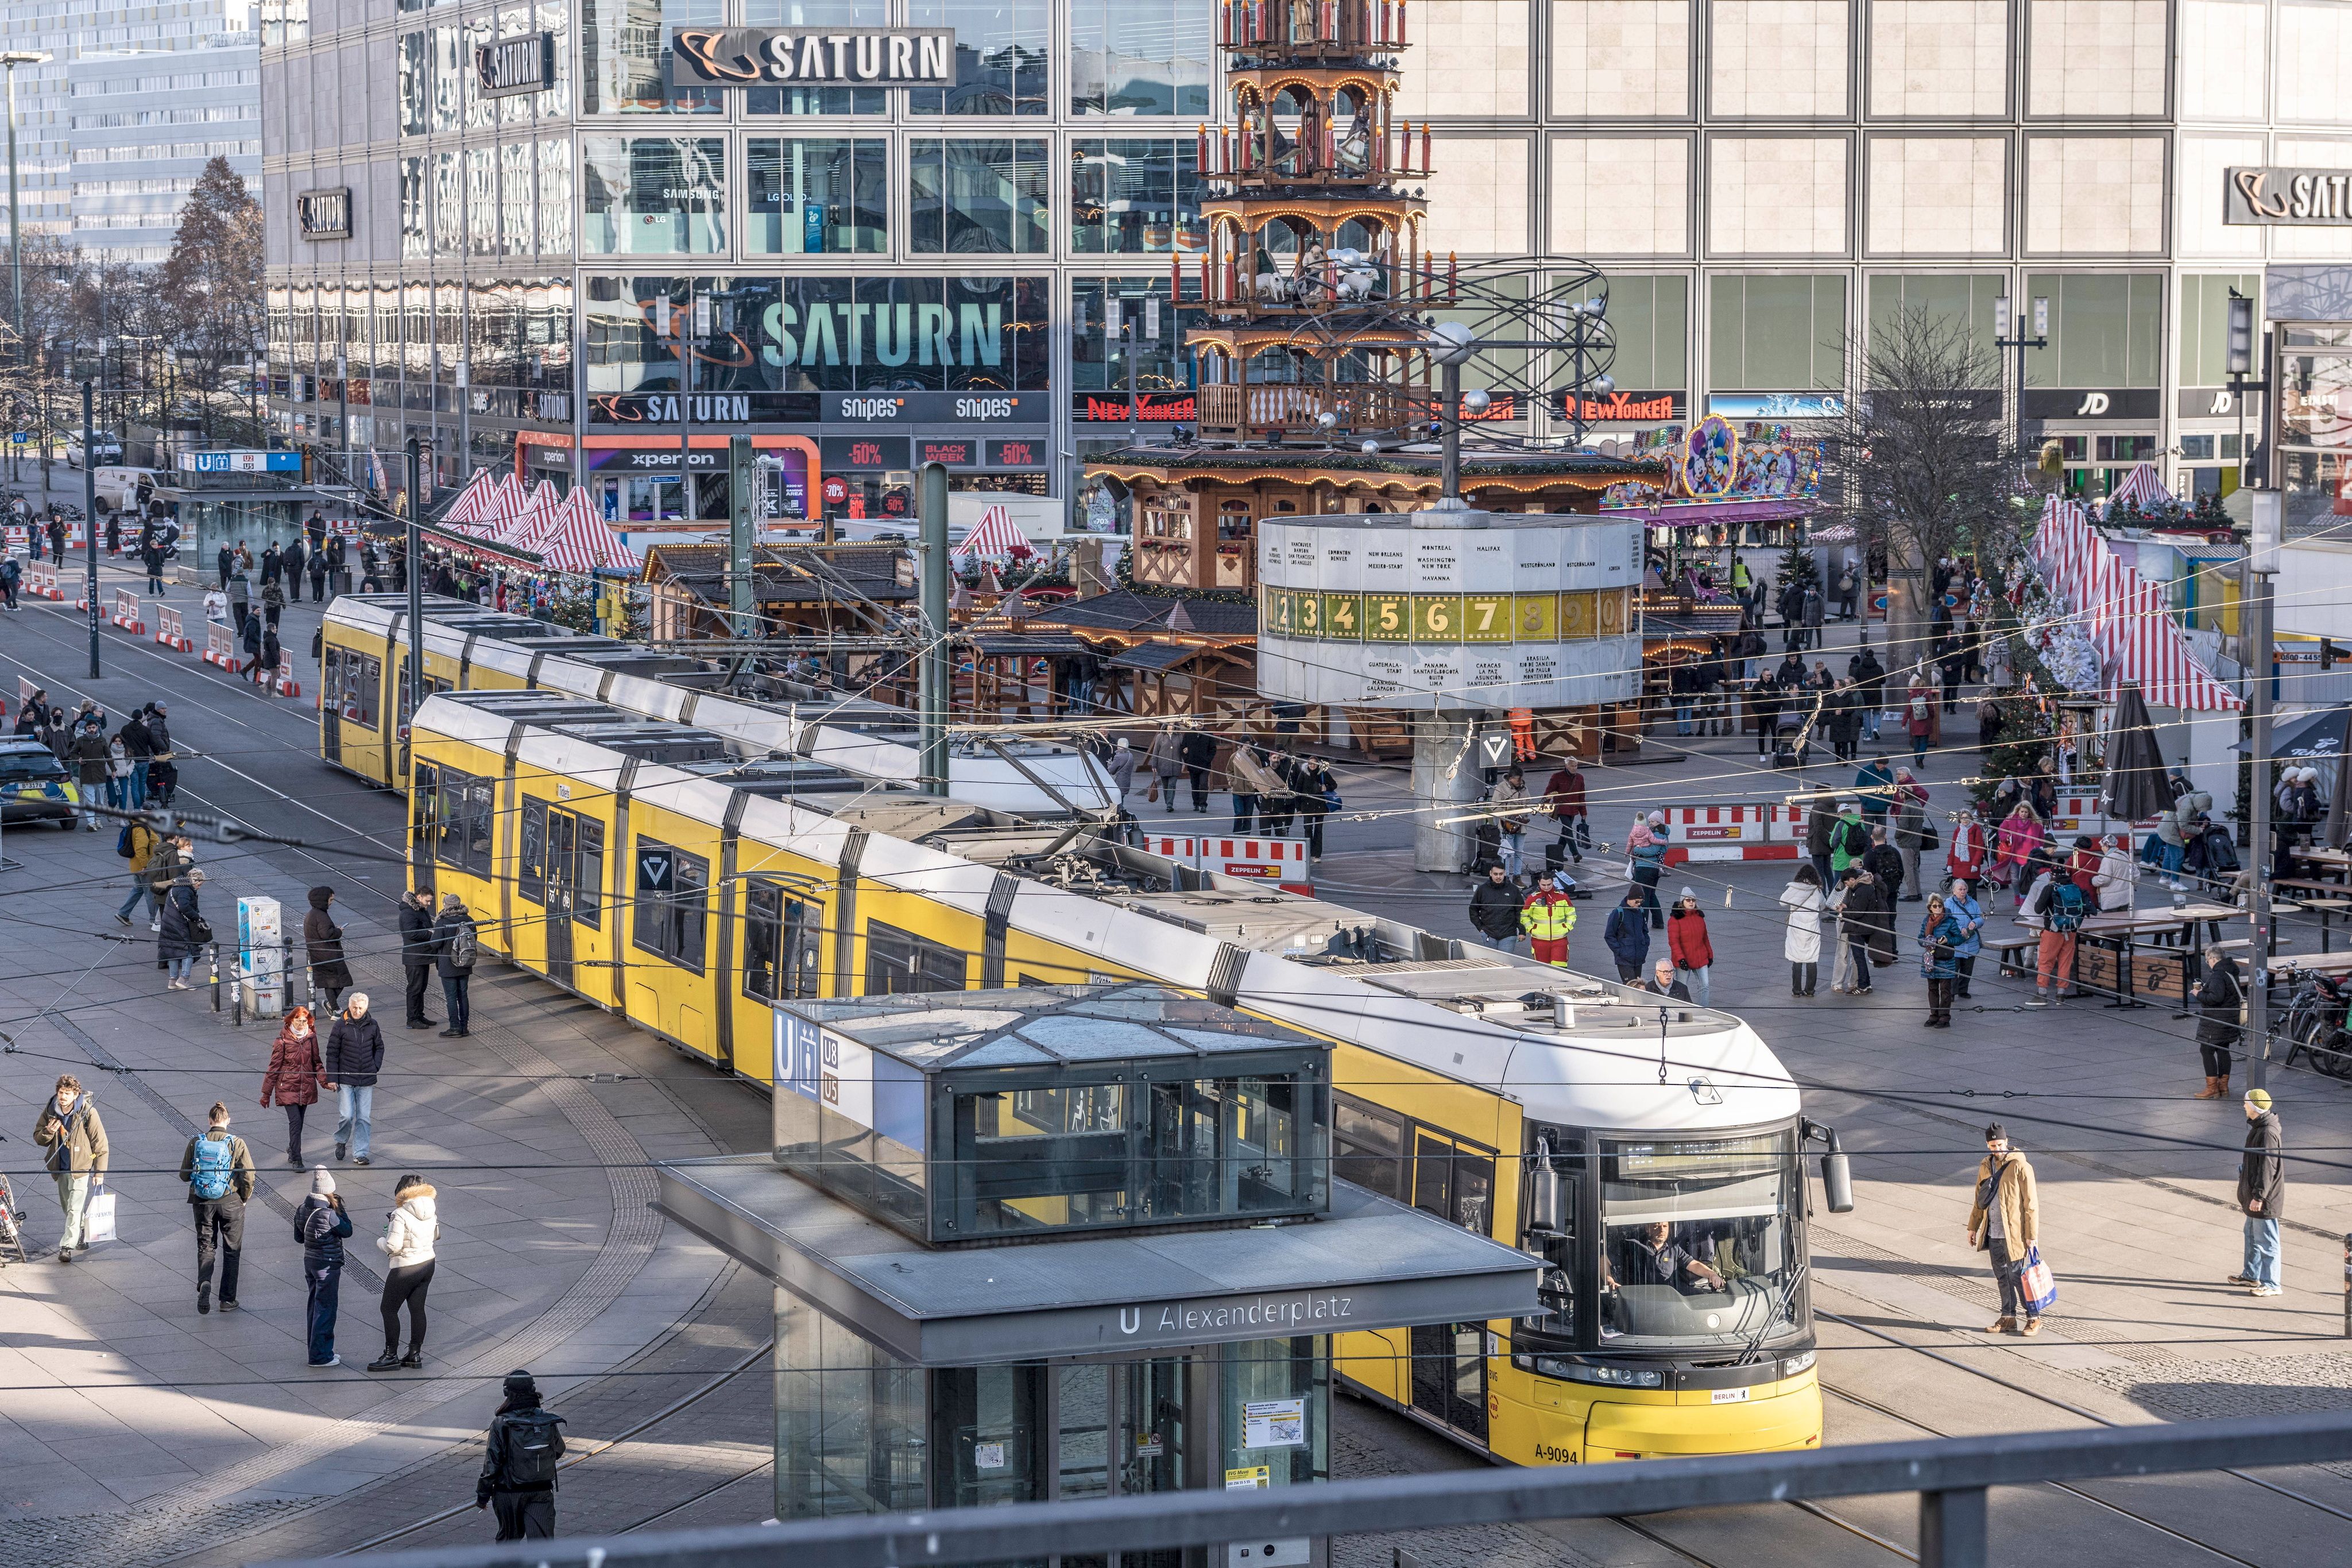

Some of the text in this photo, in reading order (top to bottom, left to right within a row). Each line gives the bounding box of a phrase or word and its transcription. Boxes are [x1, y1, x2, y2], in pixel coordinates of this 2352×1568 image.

[493, 40, 538, 88] SATURN
[770, 34, 948, 79] SATURN
[663, 188, 719, 200] SAMSUNG
[767, 192, 807, 202] LG OLD
[311, 195, 344, 233] SATURN
[762, 302, 1001, 367] SATURN
[539, 393, 566, 420] SATURN
[841, 398, 897, 421] snipes
[956, 398, 1011, 421] snipes
[1087, 394, 1195, 421] NEW YORKER
[1609, 392, 1673, 420] YORKER
[2077, 392, 2110, 415] JD
[2210, 391, 2232, 414] JD
[15, 434, 25, 443] W
[925, 444, 966, 453] BLACK
[198, 455, 211, 471] U
[543, 450, 566, 463] xperion
[632, 452, 715, 468] xperon
[848, 443, 882, 464] -50%
[925, 452, 966, 462] WEEK
[998, 443, 1032, 464] -50%
[826, 485, 844, 497] -70%
[885, 498, 904, 512] -50%
[1279, 597, 1290, 625] 2
[1303, 599, 1317, 628] 3
[1334, 601, 1355, 630] 4
[1380, 602, 1399, 631] 5
[1426, 603, 1449, 632] 6
[1474, 603, 1498, 630] 7
[1523, 601, 1544, 631] 8
[1564, 599, 1582, 629] 9
[2291, 748, 2342, 758] Tchibo
[559, 784, 570, 799] Tickets
[776, 1013, 794, 1083] U
[824, 1038, 837, 1066] U8
[824, 1074, 837, 1102] U5
[1120, 1292, 1353, 1334] U Alexanderplatz
[1489, 1369, 1498, 1383] BVG
[1490, 1401, 1498, 1412] VBB
[1535, 1443, 1578, 1466] A-9094
